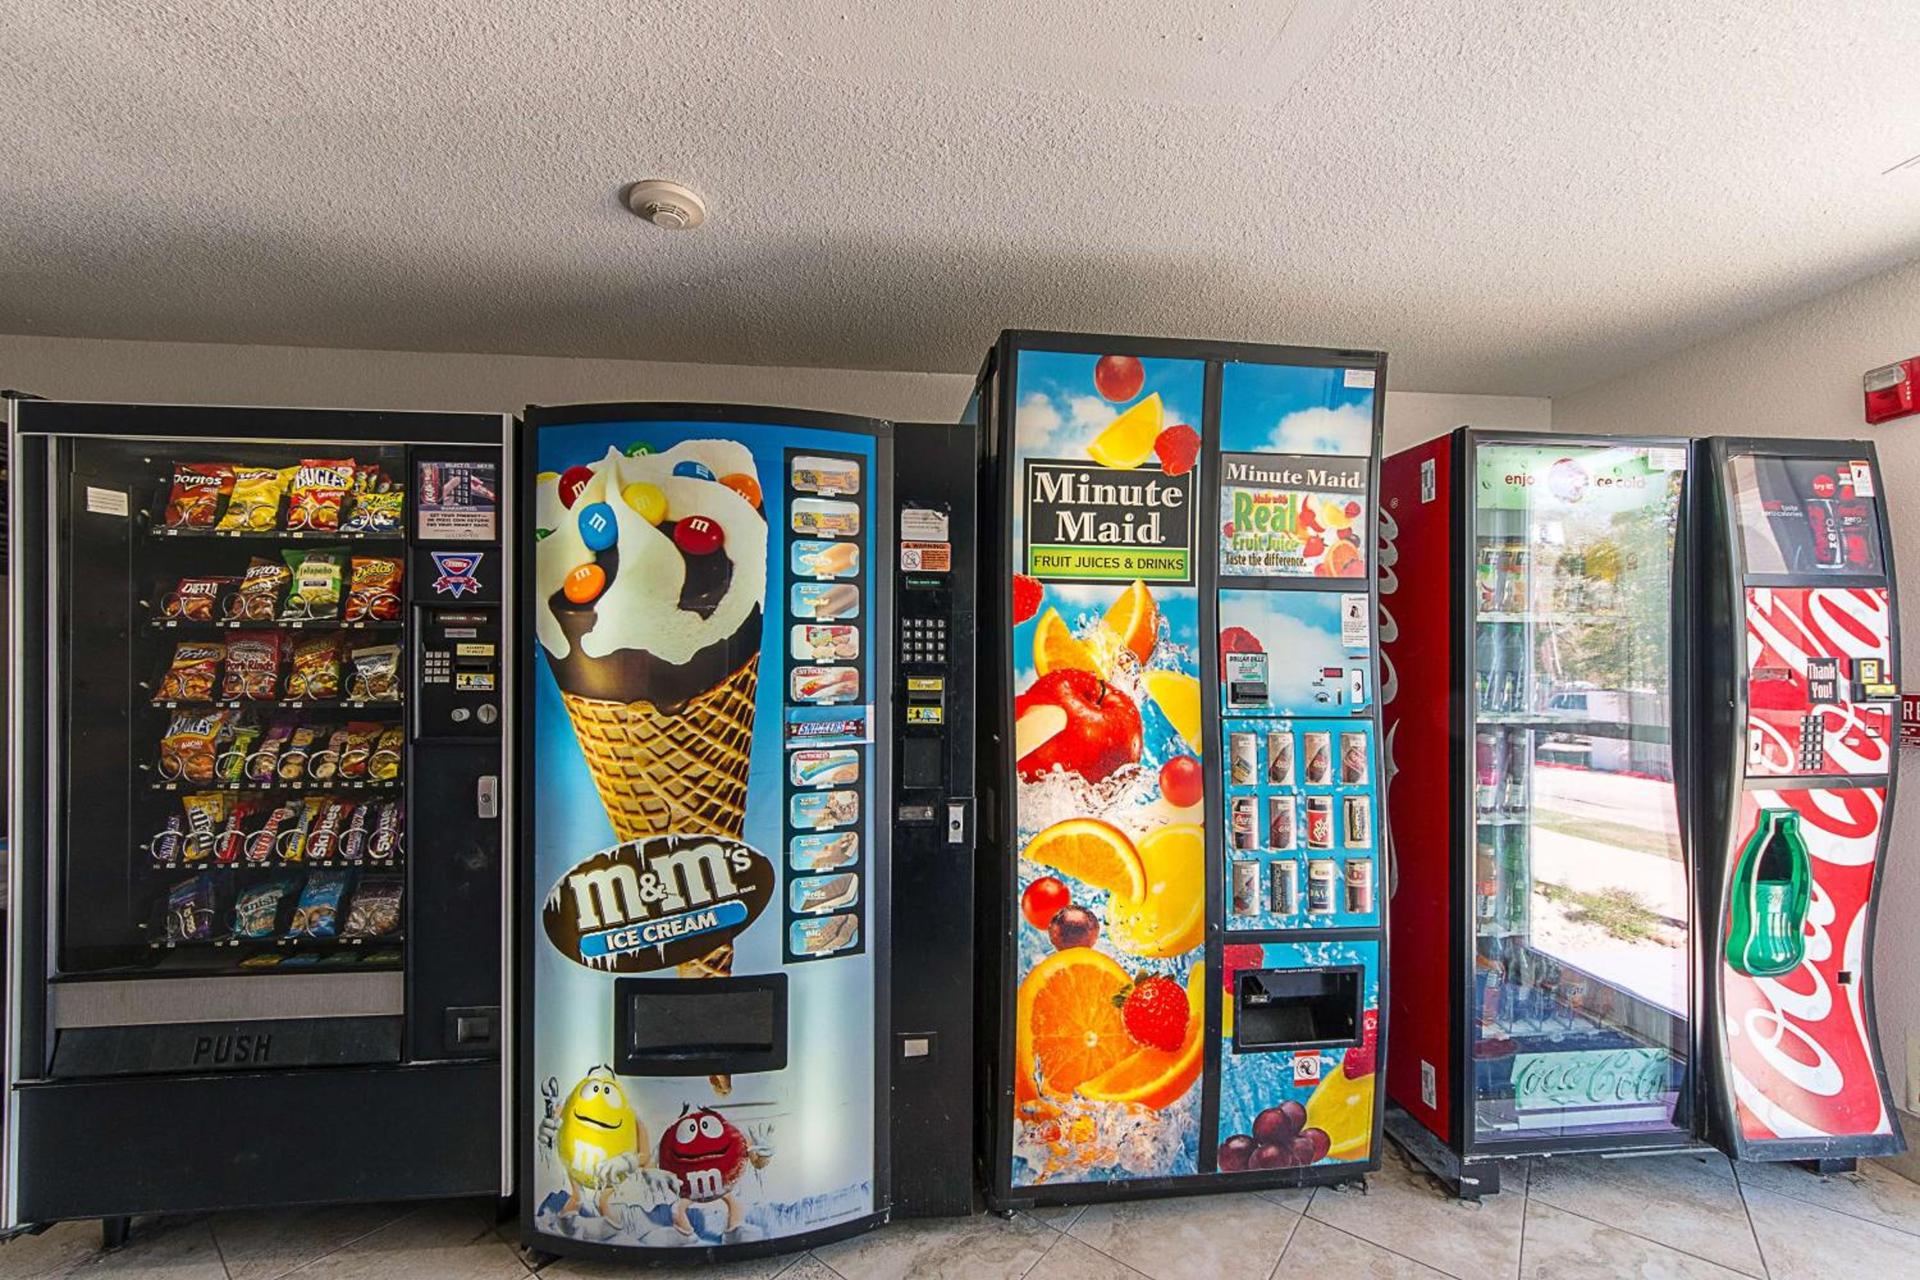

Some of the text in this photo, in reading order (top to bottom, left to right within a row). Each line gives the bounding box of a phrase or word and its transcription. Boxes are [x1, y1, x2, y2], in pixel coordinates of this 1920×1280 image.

[174, 474, 222, 486] Doritos
[1226, 463, 1303, 485] Minute
[1505, 474, 1536, 487] enjo
[1033, 472, 1183, 508] Minute
[1234, 492, 1297, 533] Real
[588, 512, 606, 532] m
[690, 518, 709, 532] m
[1825, 518, 1838, 548] zero
[1232, 534, 1262, 551] Fruit
[1034, 556, 1184, 570] FRUIT JUICES & DRINKS
[1225, 552, 1247, 565] Taste
[1248, 553, 1262, 566] the
[575, 567, 591, 581] m
[1808, 664, 1836, 680] Thank
[1811, 682, 1833, 699] You!
[607, 912, 717, 951] ICE CREAM
[193, 1034, 271, 1064] PUSH
[686, 1168, 723, 1200] m
